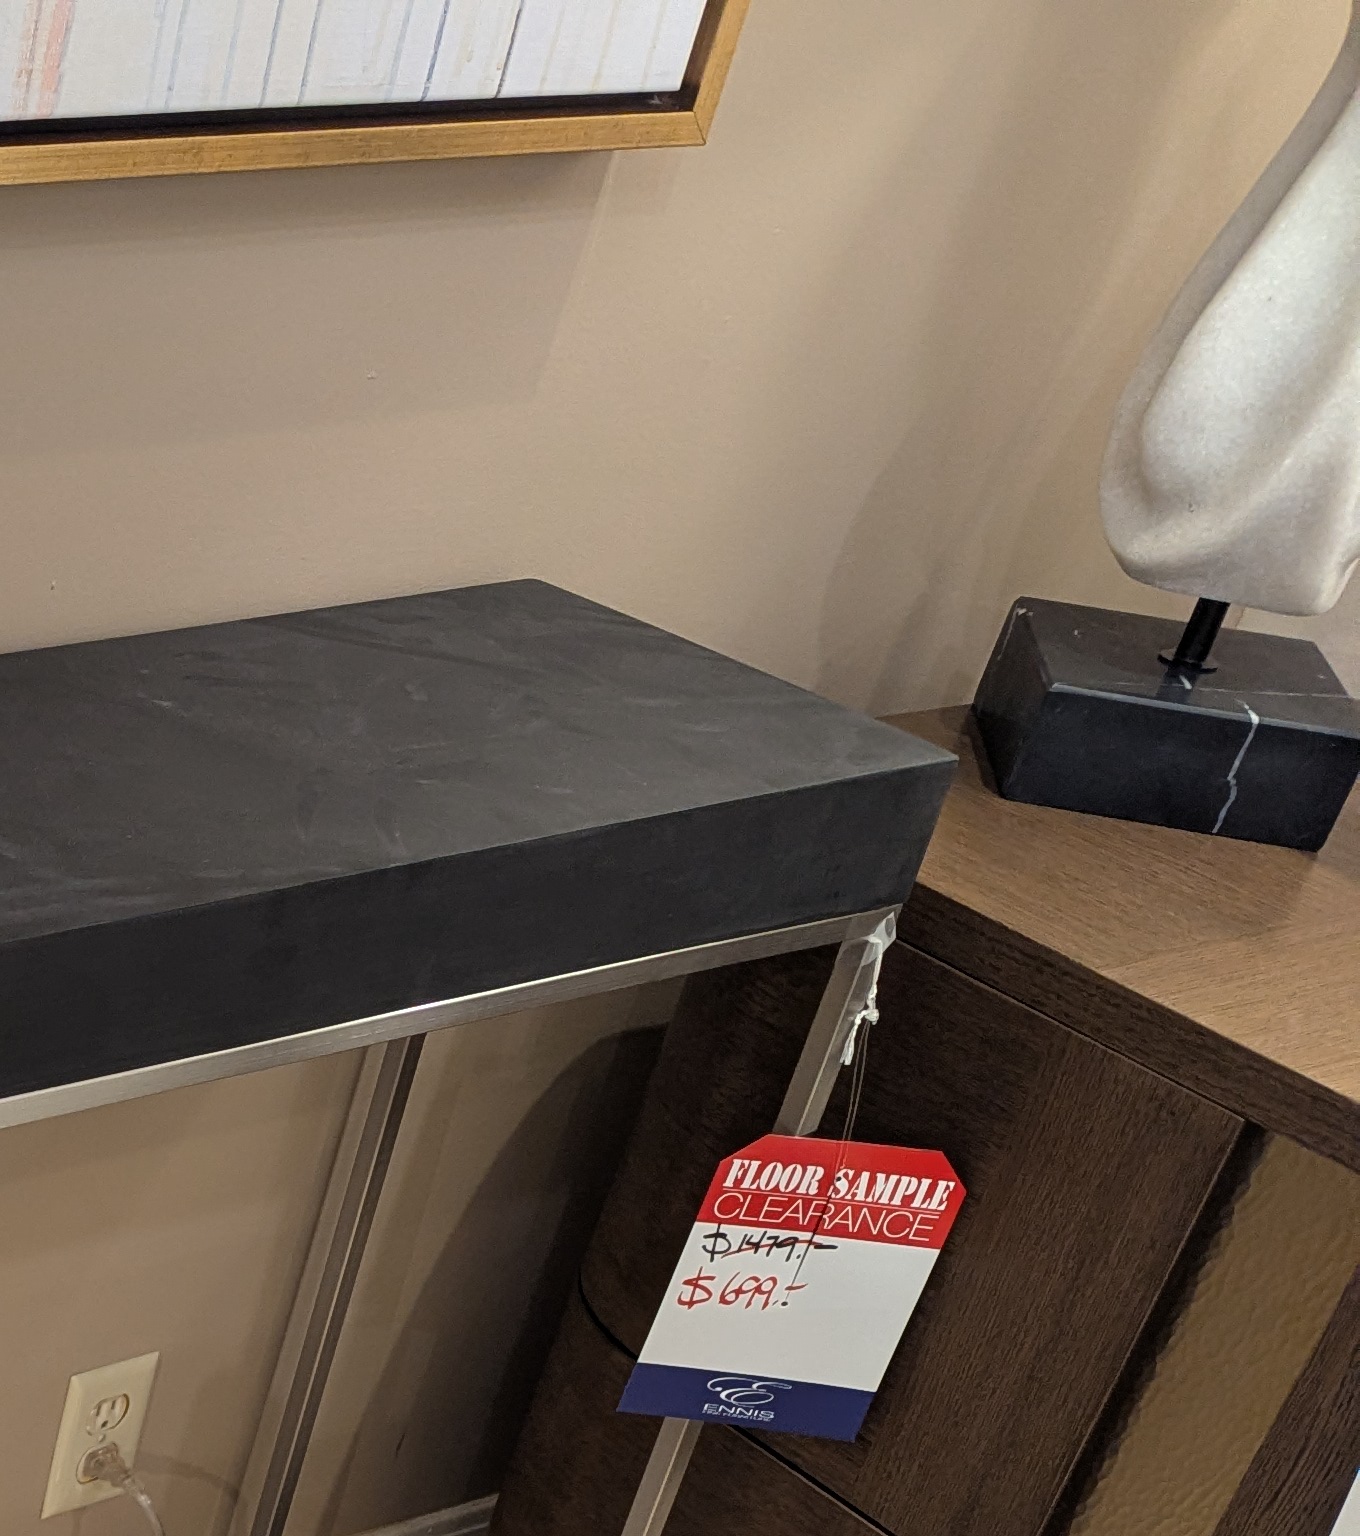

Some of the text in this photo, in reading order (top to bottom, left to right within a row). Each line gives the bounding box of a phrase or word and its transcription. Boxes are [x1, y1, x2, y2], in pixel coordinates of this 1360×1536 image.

[722, 1158, 955, 1212] FLOOR SAMPLE
[713, 1192, 940, 1242] CLEARANCE
[703, 1403, 775, 1419] ENNIS
